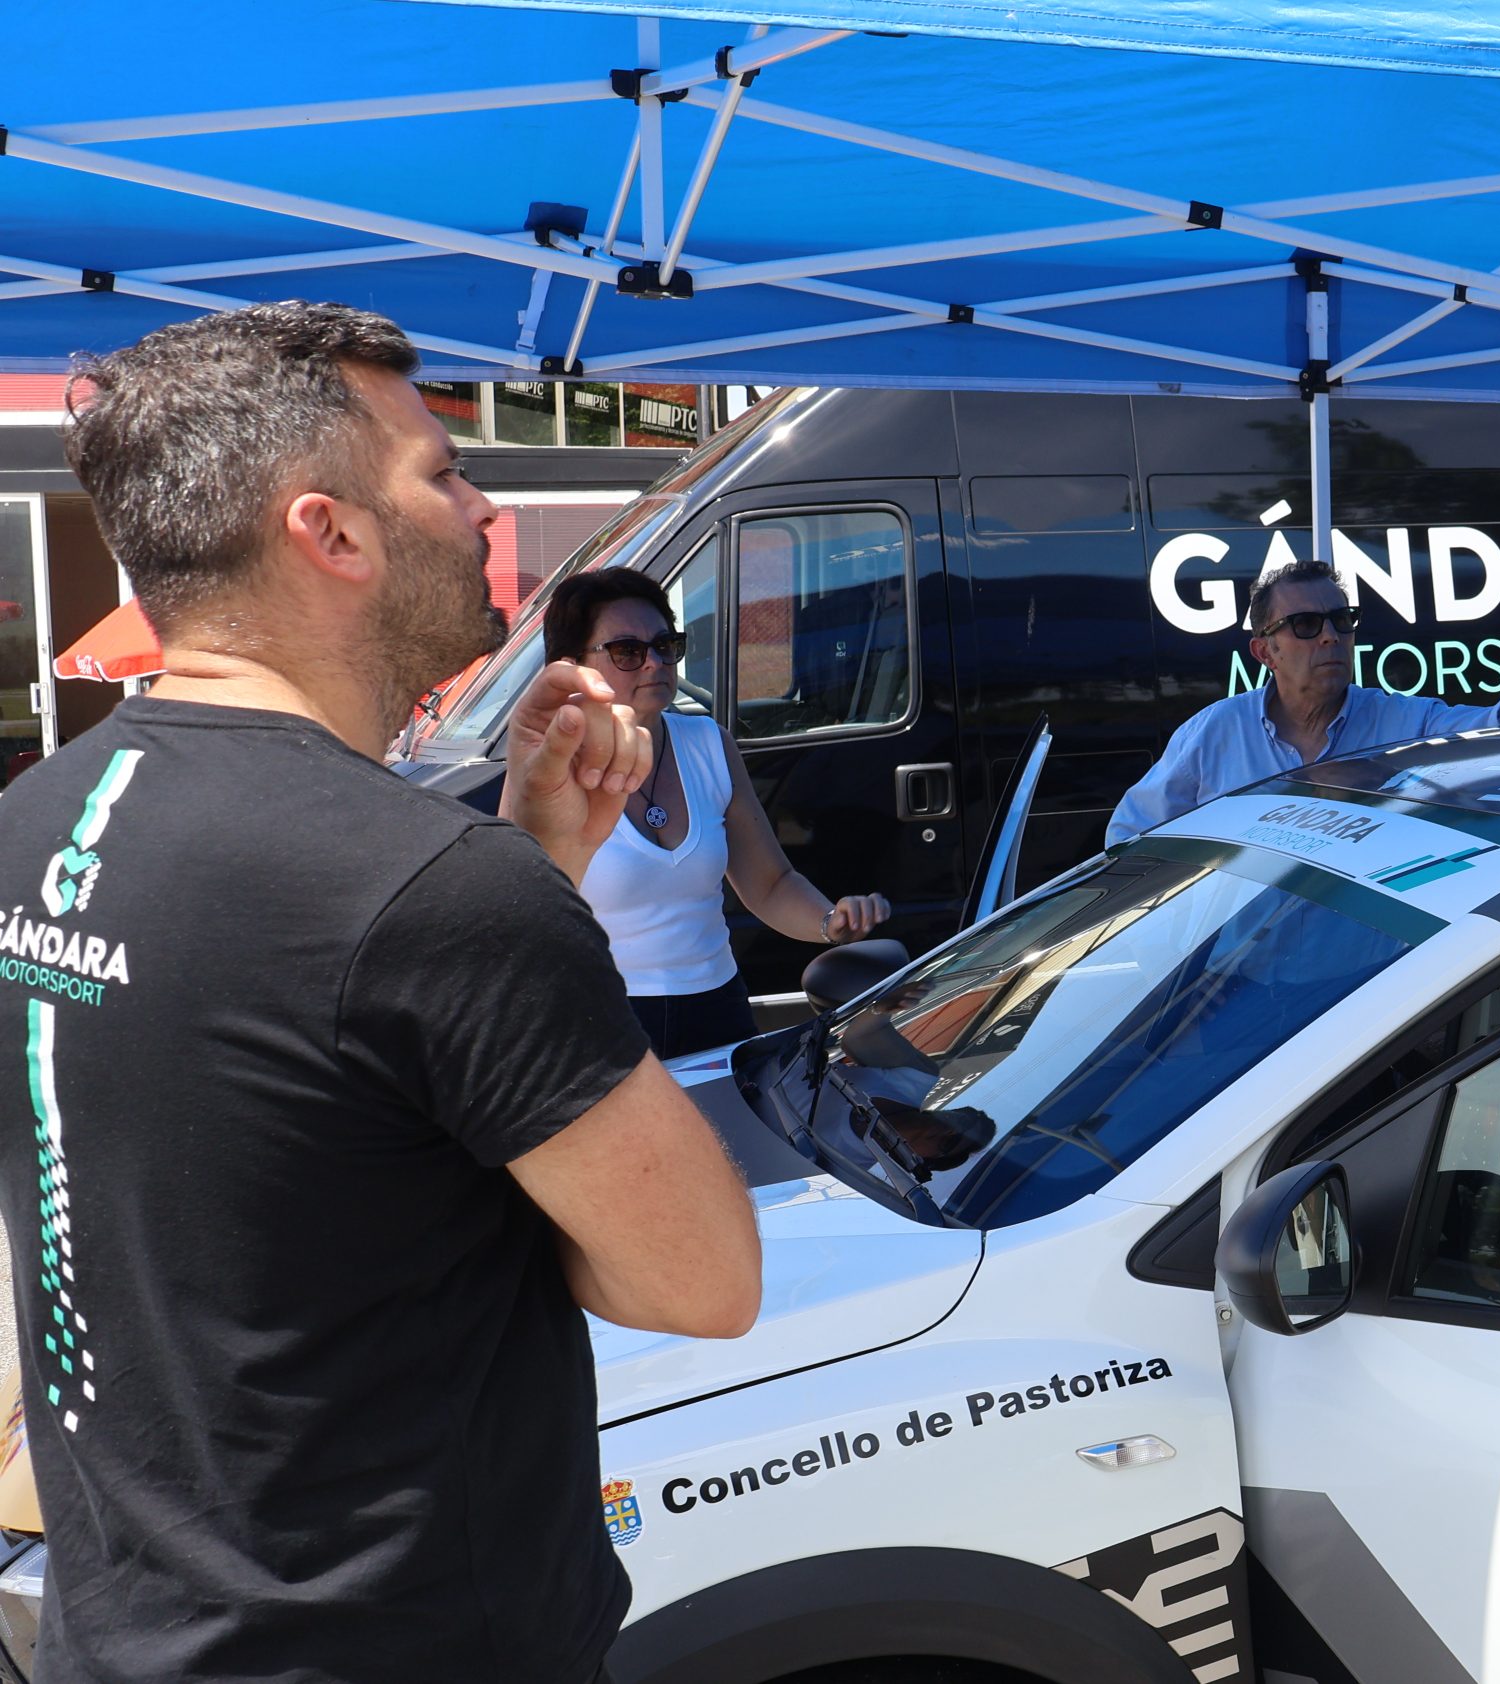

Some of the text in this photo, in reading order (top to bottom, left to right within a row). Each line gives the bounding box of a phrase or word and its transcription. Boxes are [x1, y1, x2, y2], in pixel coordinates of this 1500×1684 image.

[525, 382, 544, 396] PTC
[593, 396, 609, 410] PTC
[671, 405, 697, 432] PTC
[1258, 801, 1386, 844] GÁNDARA
[1239, 825, 1334, 855] MOTORSPORT
[661, 1356, 1173, 1514] Concello de Pastoriza
